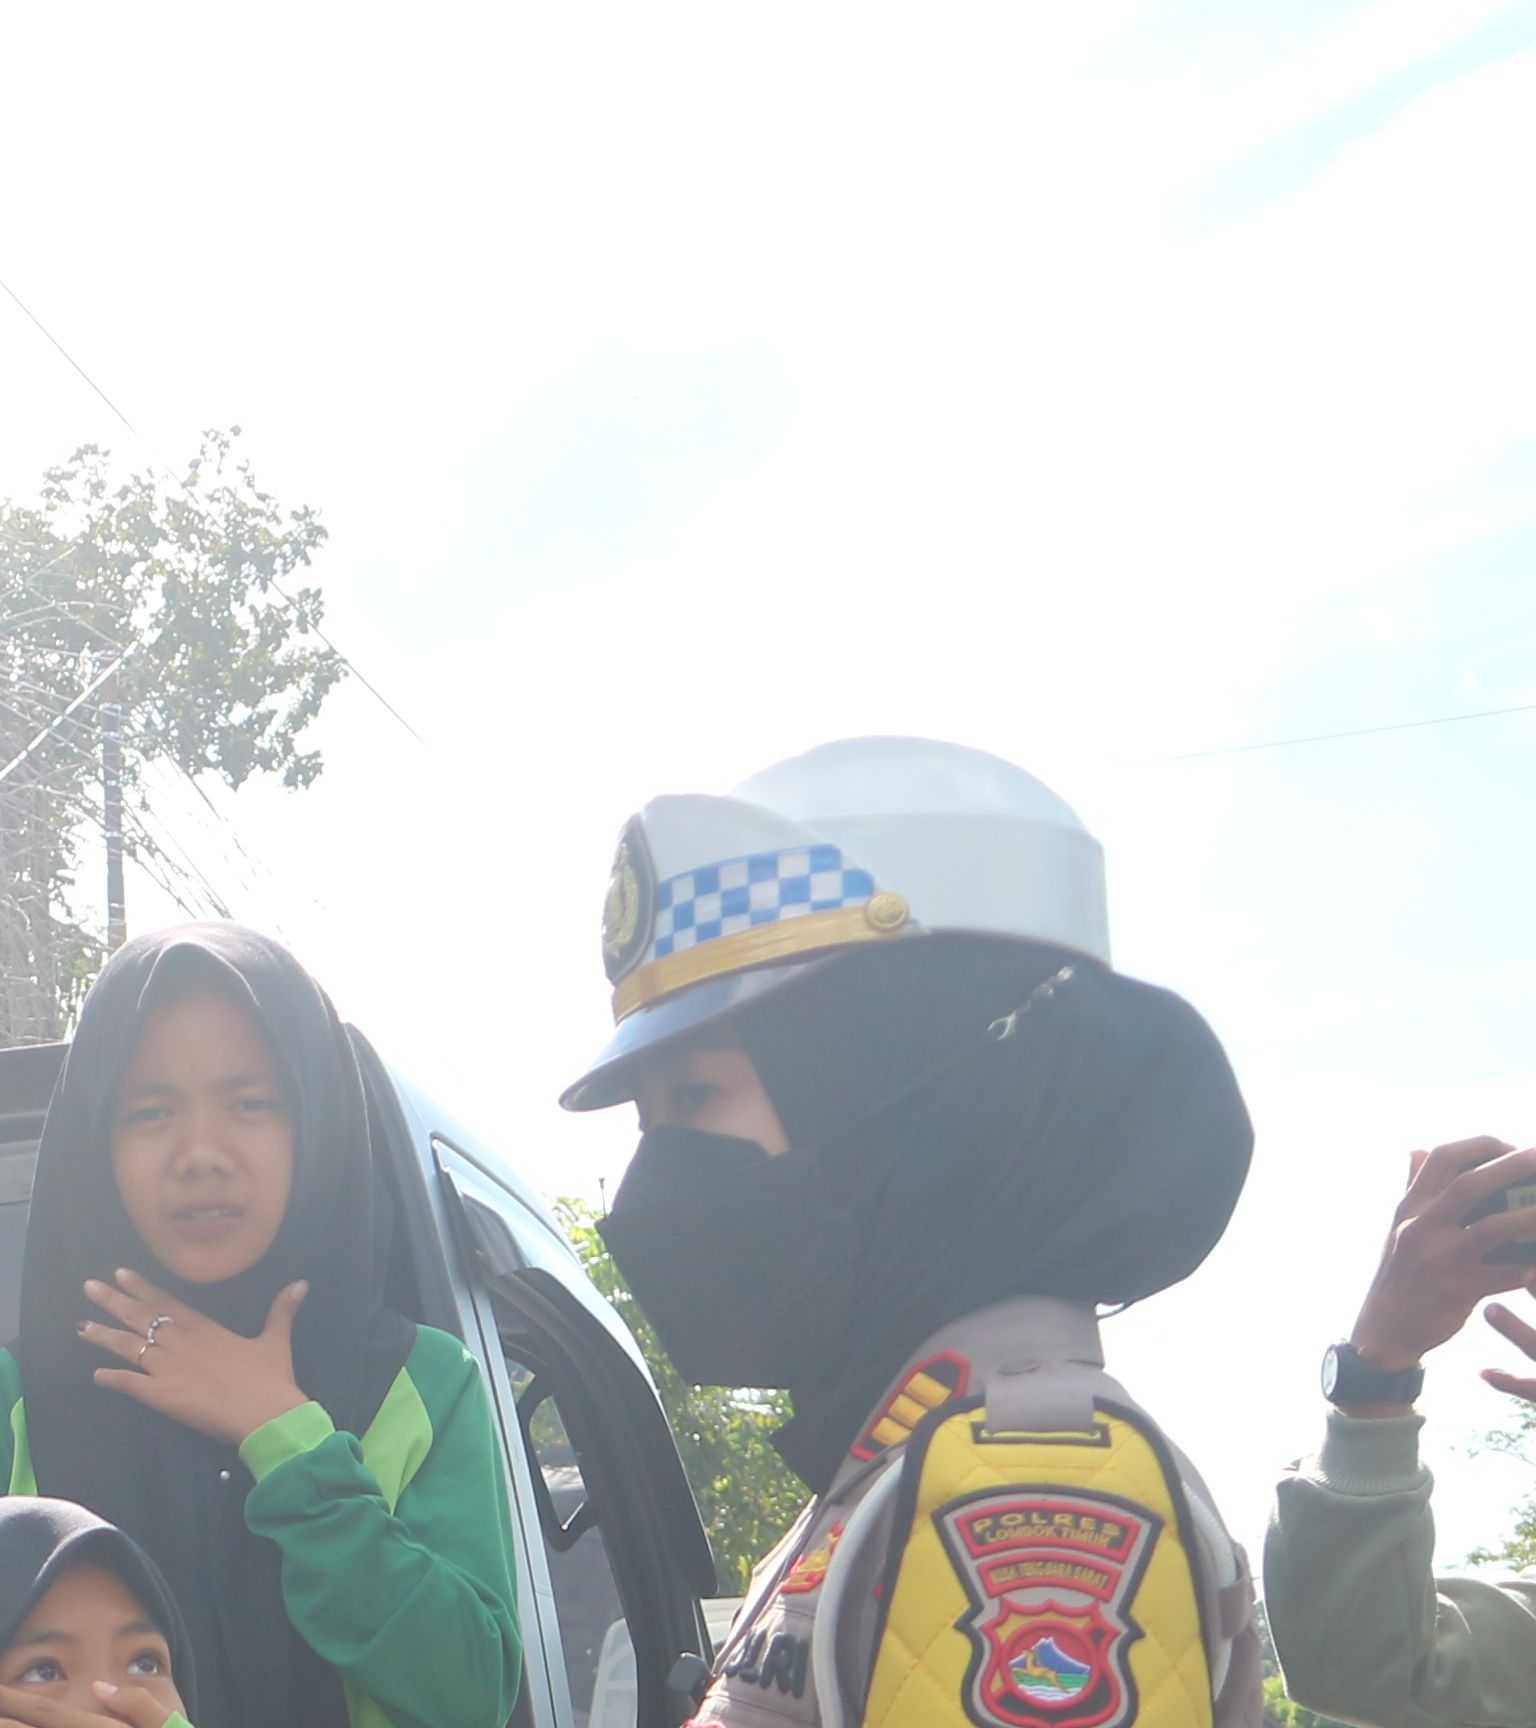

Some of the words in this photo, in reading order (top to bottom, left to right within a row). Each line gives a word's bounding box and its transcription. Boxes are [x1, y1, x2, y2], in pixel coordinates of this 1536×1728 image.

[971, 1511, 1122, 1538] POLRES
[985, 1523, 1058, 1543] LOMBOK
[1062, 1526, 1114, 1548] TIMUR
